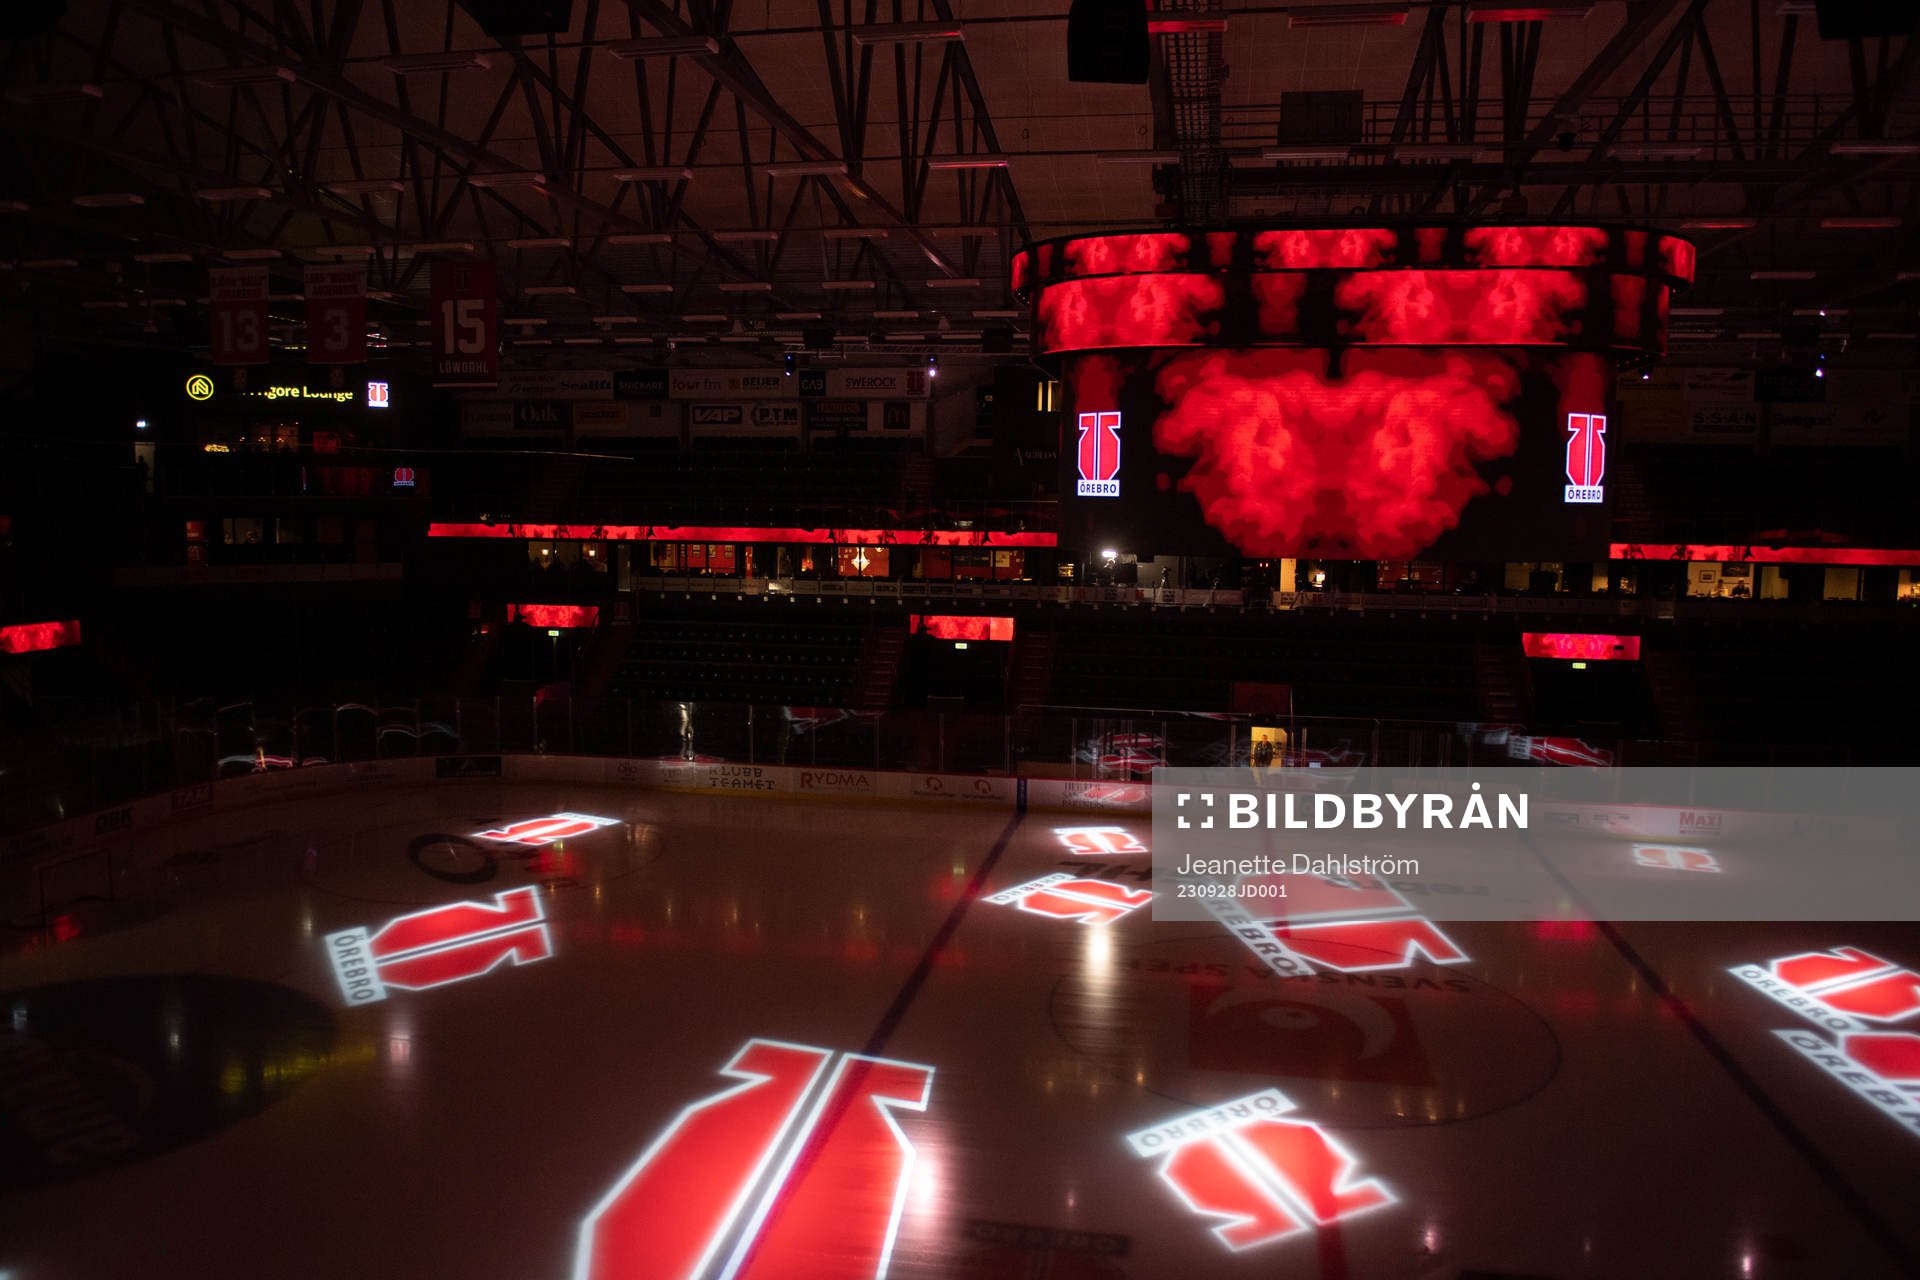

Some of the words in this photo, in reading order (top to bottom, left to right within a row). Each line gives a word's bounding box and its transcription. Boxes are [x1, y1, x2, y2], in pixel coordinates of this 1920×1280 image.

[219, 310, 260, 356] 13
[323, 310, 351, 355] 3
[440, 298, 485, 354] 15
[742, 376, 780, 387] BEIJER
[846, 376, 896, 388] SWEROCK
[694, 407, 740, 422] VAP
[1080, 482, 1117, 494] ÖREBRO
[1567, 487, 1601, 500] ÖREBRO
[709, 765, 762, 777] KLUBB
[709, 777, 776, 790] TEAMET
[800, 771, 870, 788] RYDMA
[333, 934, 376, 1001] ÖREBRO
[1741, 968, 1851, 1031] ÖREBRO
[1140, 1095, 1279, 1149] ÖREBRO
